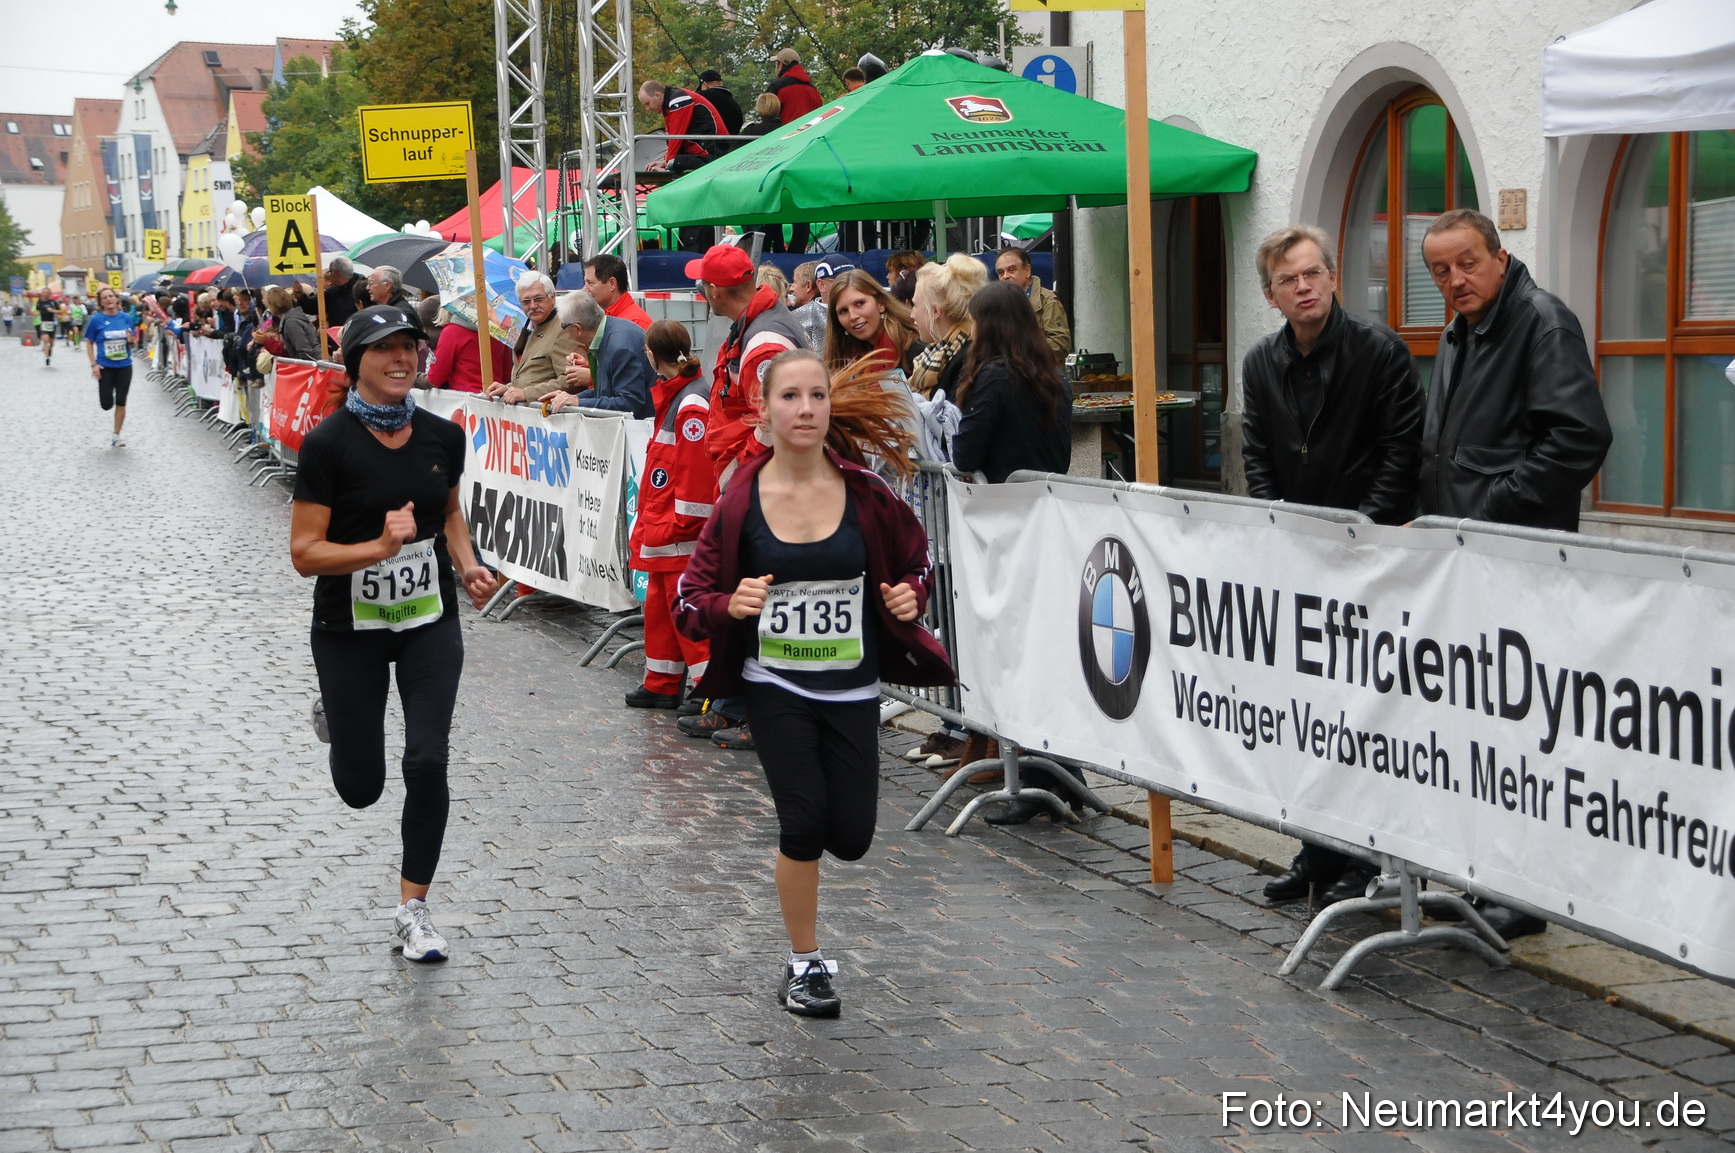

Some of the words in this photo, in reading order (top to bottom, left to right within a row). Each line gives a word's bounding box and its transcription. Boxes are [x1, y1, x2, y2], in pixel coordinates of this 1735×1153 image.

[368, 127, 464, 143] Schnupper-
[930, 128, 1069, 142] Neumarkter
[403, 146, 433, 162] lauf
[911, 139, 1108, 157] Lammsbräu
[270, 198, 311, 213] Block
[280, 219, 309, 257] A
[151, 239, 162, 255] B
[112, 276, 120, 287] C
[386, 551, 423, 566] Neumarkt
[1083, 541, 1143, 604] BMW
[362, 562, 431, 600] 5134
[800, 588, 845, 596] Neumarkt
[379, 605, 417, 623] Brigitte
[770, 600, 852, 635] 5135
[783, 643, 837, 658] Ramona
[1166, 572, 1280, 666] BMW
[1294, 592, 1735, 774] EfficientDynami
[1171, 669, 1286, 751] Weniger
[1291, 697, 1460, 794] Verbrauch.
[1470, 740, 1554, 822] Mehr
[1564, 766, 1735, 882] Fahrfreu
